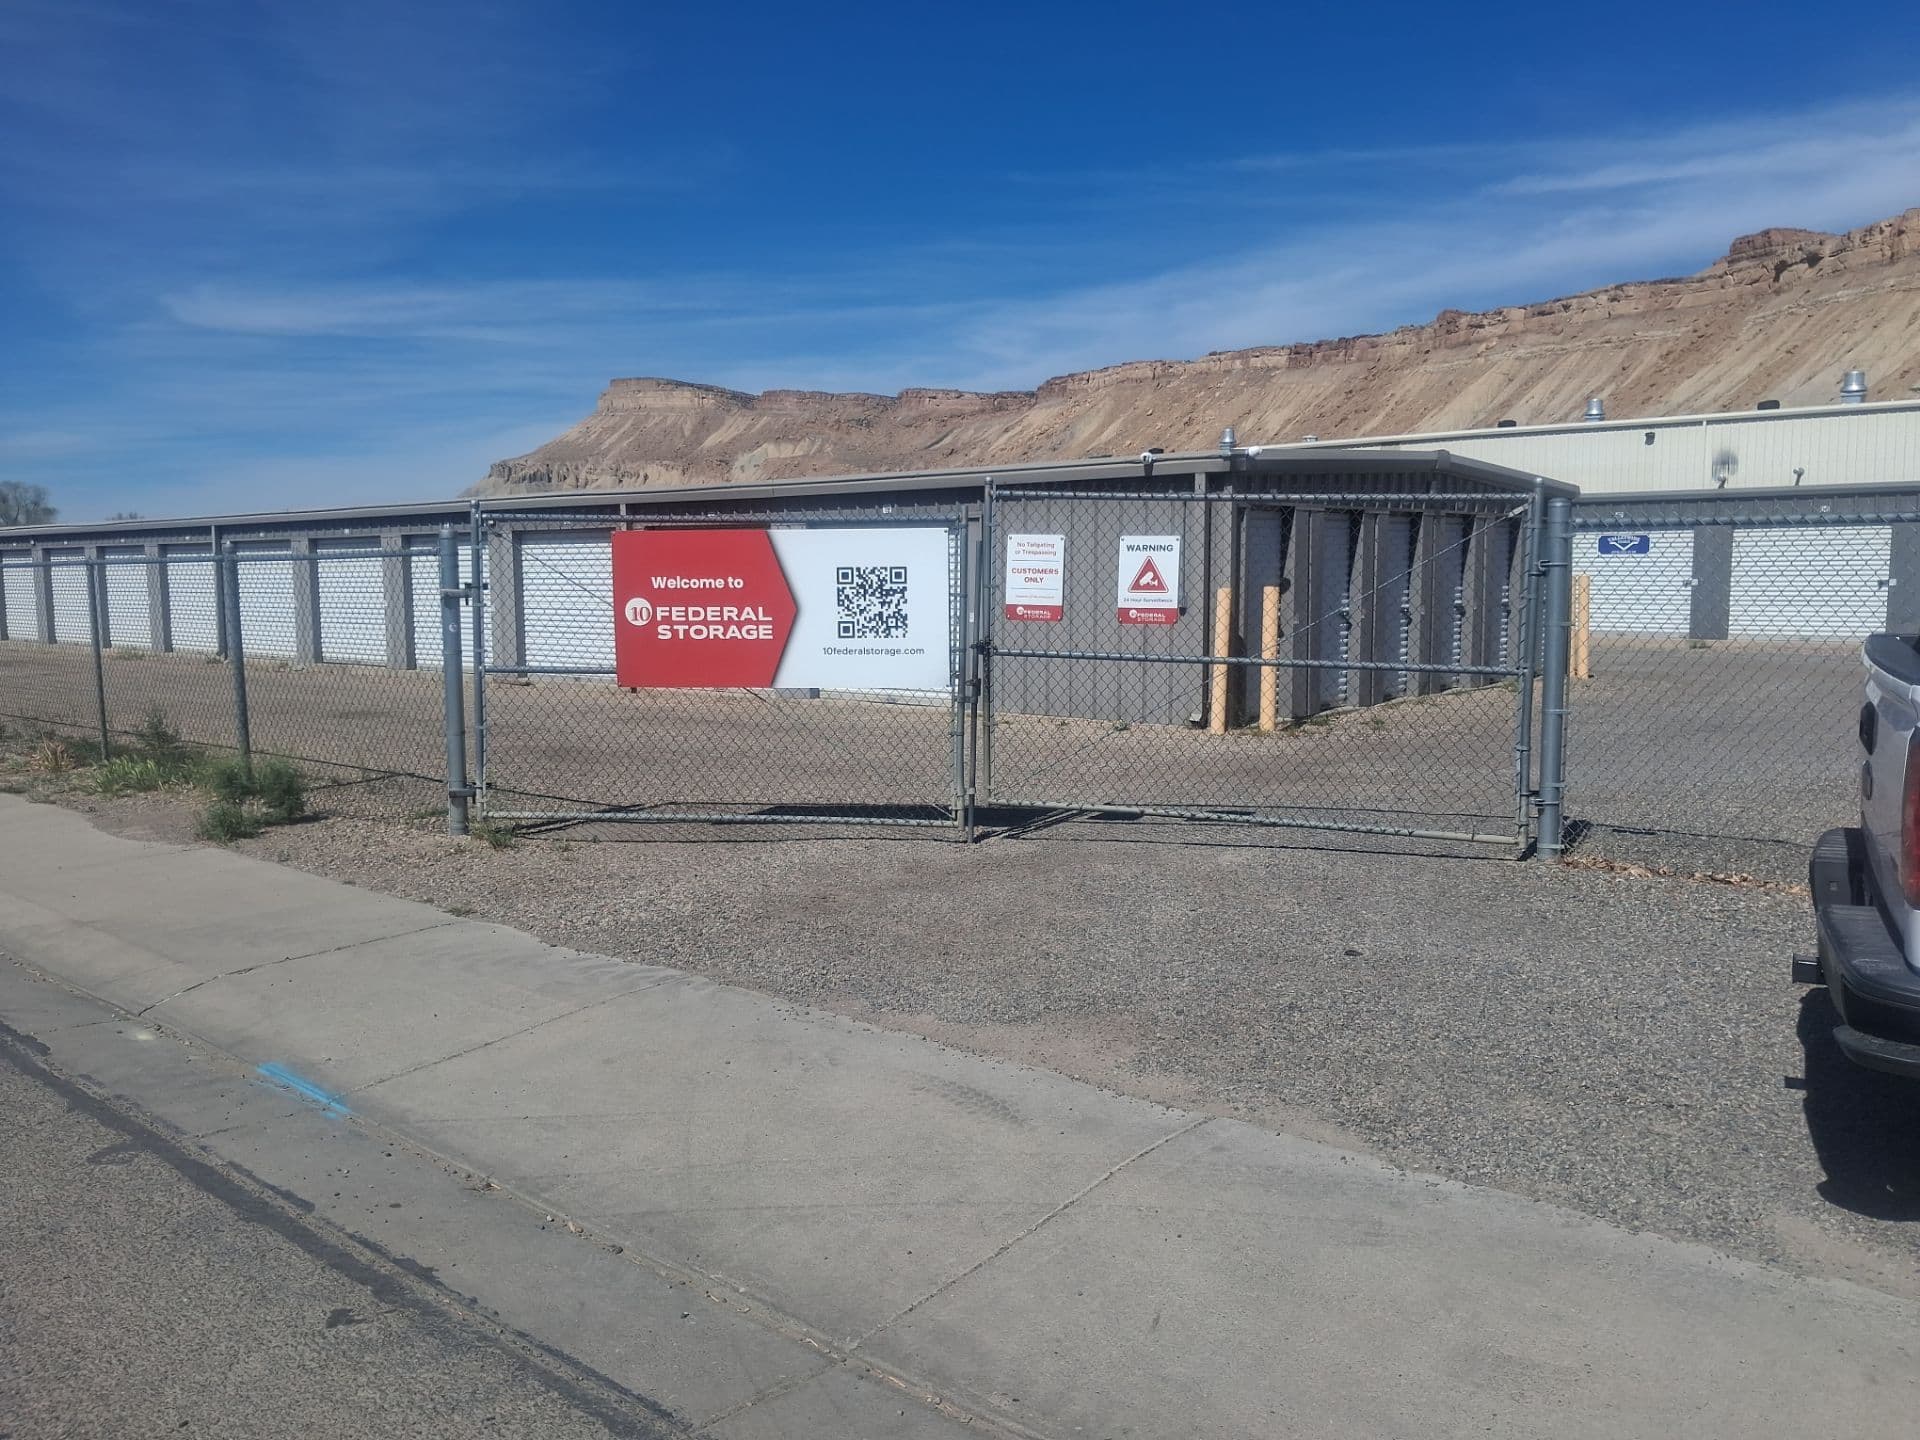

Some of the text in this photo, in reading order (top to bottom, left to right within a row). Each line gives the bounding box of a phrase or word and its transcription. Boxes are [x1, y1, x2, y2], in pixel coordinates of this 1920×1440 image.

[1126, 544, 1174, 552] WARNING
[1011, 567, 1059, 575] CUSTOMERS
[651, 575, 744, 590] Welcome to
[1024, 576, 1044, 584] ONLY
[630, 605, 773, 623] 10 FEDERAL
[657, 623, 774, 641] STORAGE
[822, 646, 926, 657] 10federalstorage.com
